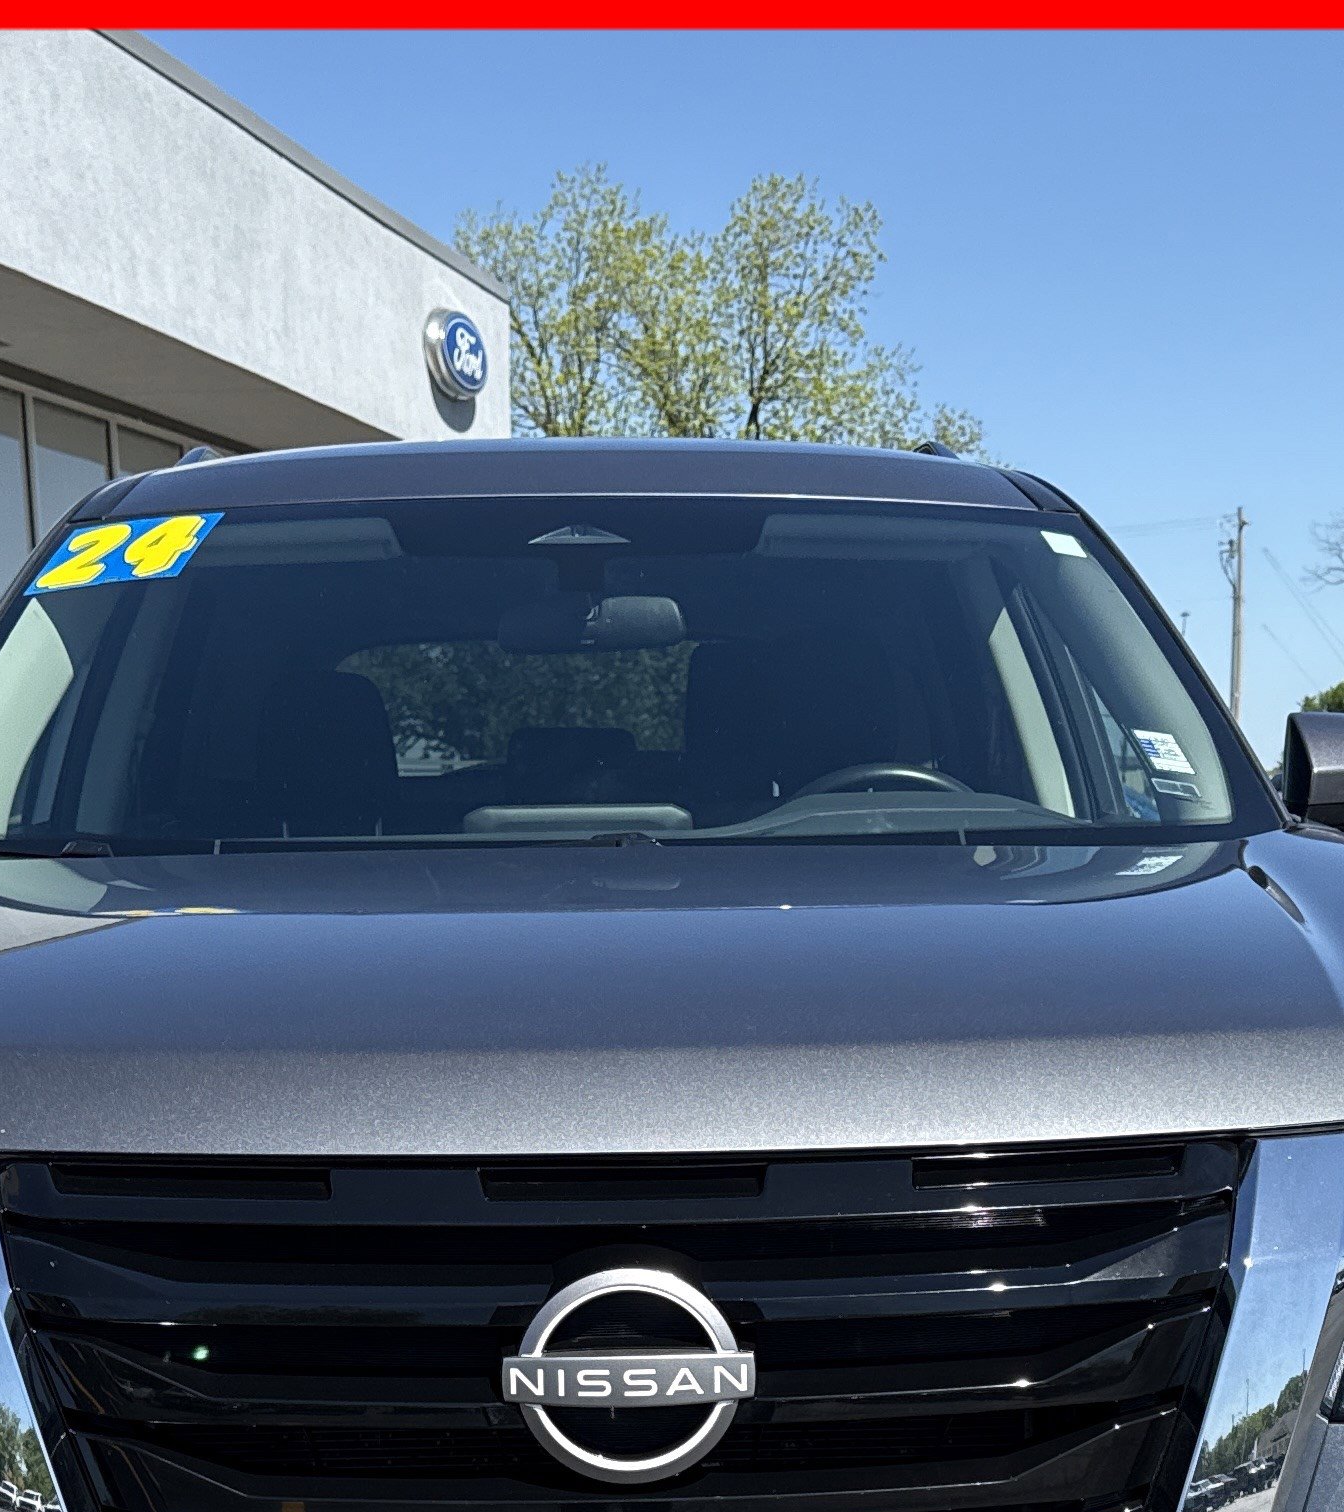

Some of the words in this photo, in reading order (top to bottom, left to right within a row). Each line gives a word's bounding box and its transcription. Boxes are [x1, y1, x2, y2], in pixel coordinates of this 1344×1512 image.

[453, 327, 483, 380] Ford
[34, 514, 207, 590] 24
[508, 1363, 749, 1398] NISSAN
